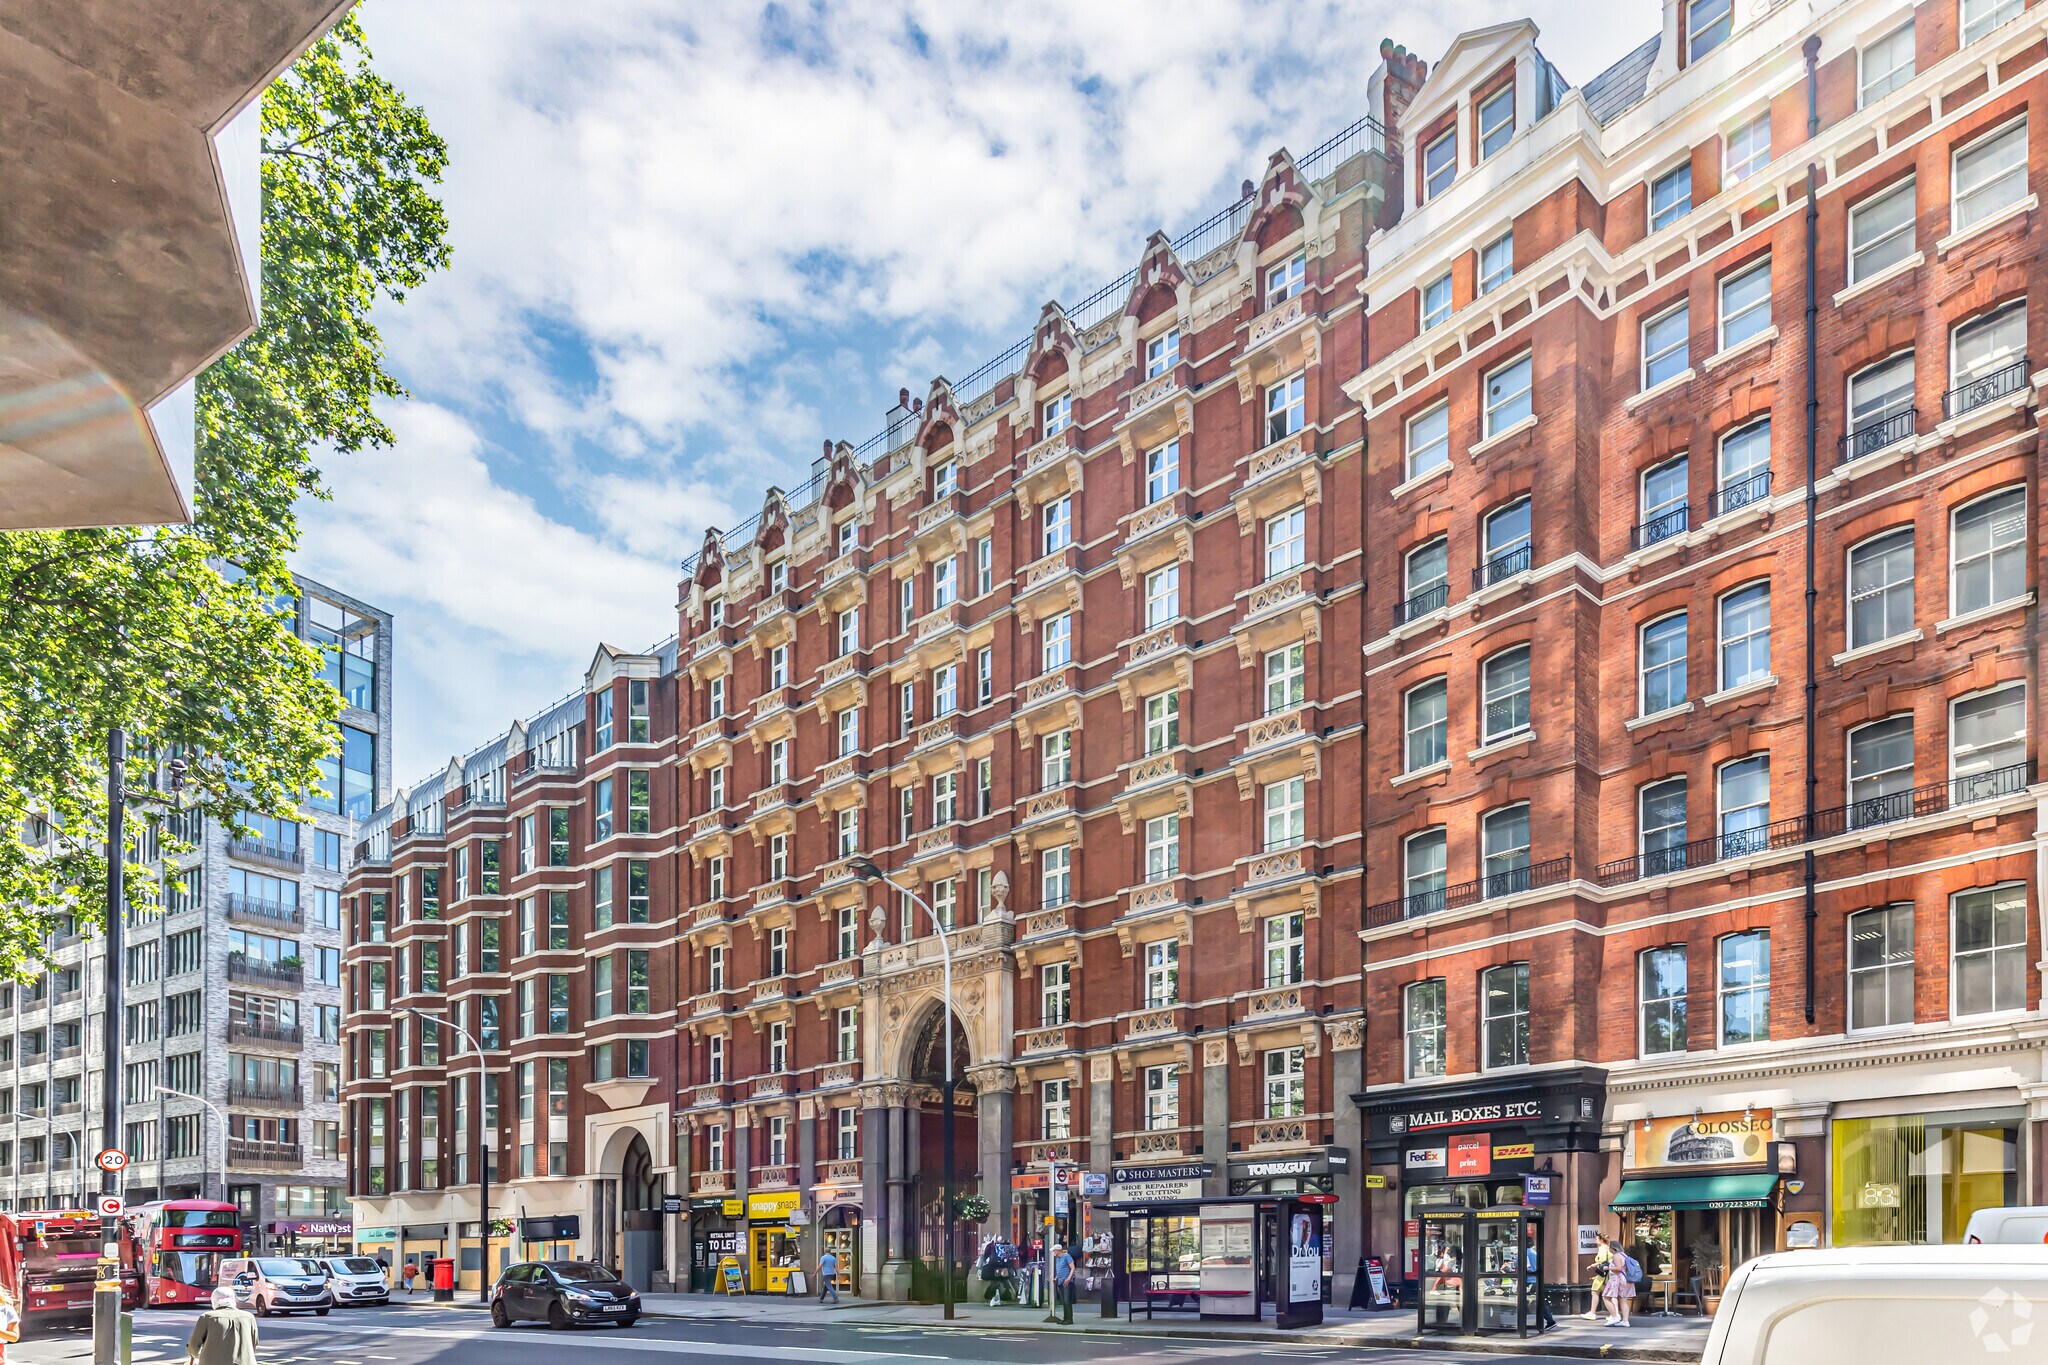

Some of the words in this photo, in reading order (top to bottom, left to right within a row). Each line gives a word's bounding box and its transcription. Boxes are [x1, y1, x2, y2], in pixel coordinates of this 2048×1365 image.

[1409, 1111, 1448, 1127] MAIL
[1451, 1105, 1501, 1123] BOXES
[1505, 1101, 1542, 1118] ETC.
[1686, 1119, 1772, 1135] COLOSSEO
[1457, 1141, 1480, 1151] parcel
[1409, 1150, 1439, 1162] FedEx
[1497, 1146, 1529, 1157] DHL
[104, 1155, 124, 1165] 20
[1459, 1158, 1477, 1168] print
[1129, 1169, 1156, 1179] SHOE
[1157, 1167, 1200, 1178] MASTERS
[1247, 1161, 1312, 1176] TONI&GUY
[1457, 1168, 1480, 1176] centre
[1145, 1182, 1189, 1190] REPAIRERS
[1529, 1179, 1546, 1190] FedEx
[833, 1190, 856, 1200] Jasmine
[310, 1224, 351, 1233] NatWest
[1580, 1229, 1599, 1239] ITALIAN
[217, 1237, 229, 1245] 24
[708, 1240, 719, 1250] TO
[721, 1240, 736, 1250] LET
[1303, 1244, 1319, 1257] You
